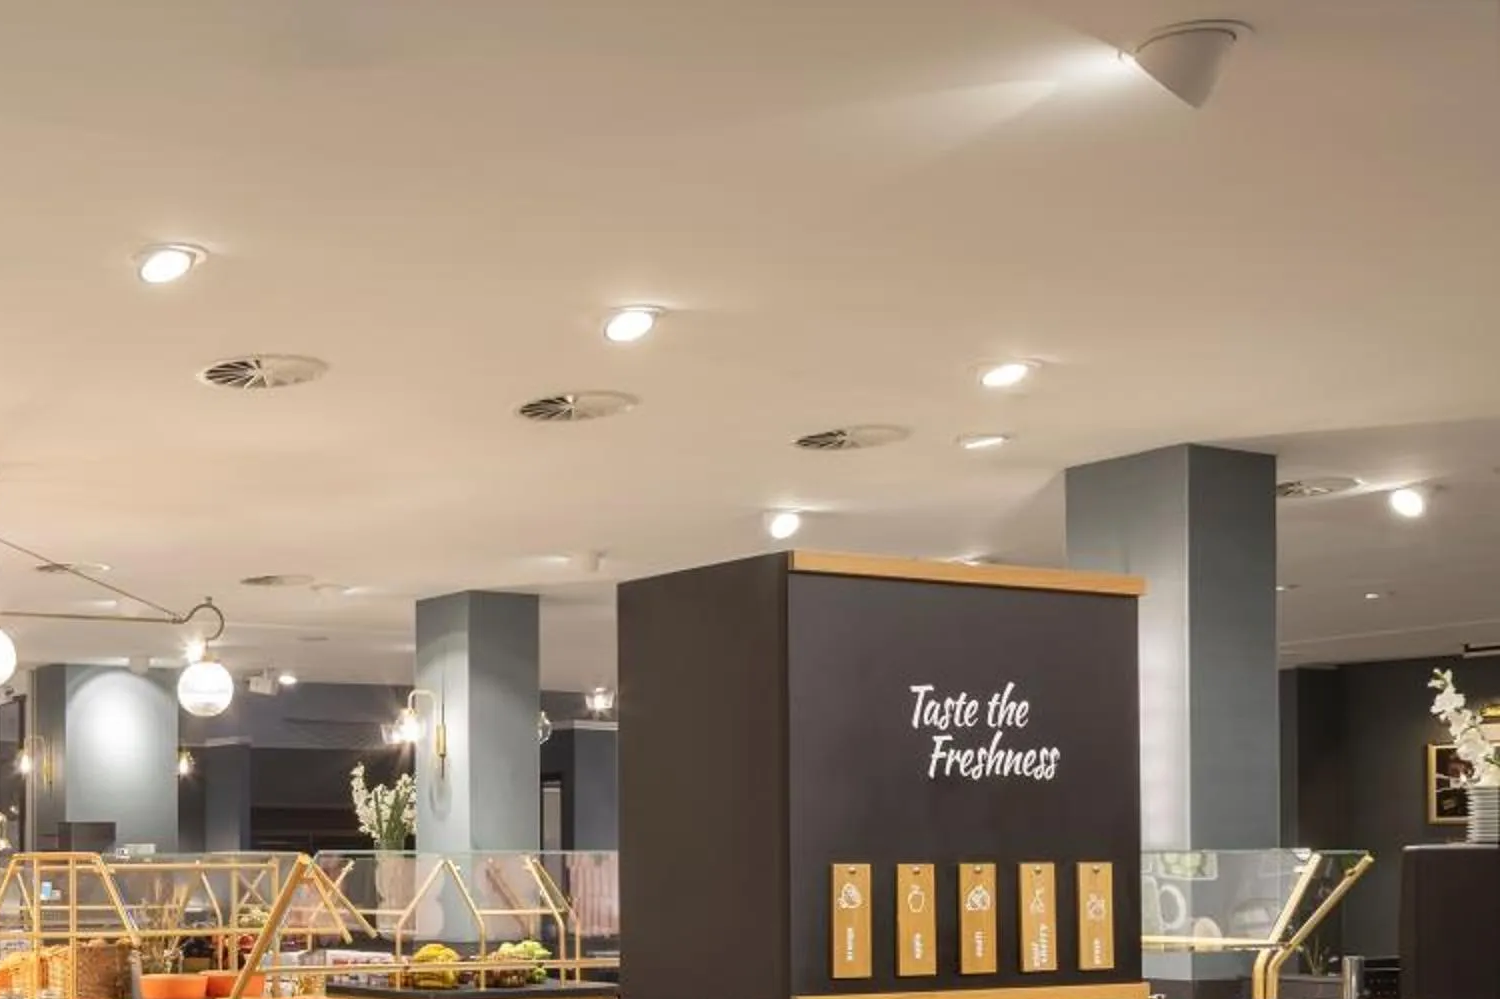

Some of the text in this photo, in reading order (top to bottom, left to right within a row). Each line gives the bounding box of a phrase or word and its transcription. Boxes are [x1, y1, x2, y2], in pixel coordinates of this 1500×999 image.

[909, 681, 1030, 729] Taste the
[928, 730, 1061, 780] Freshness
